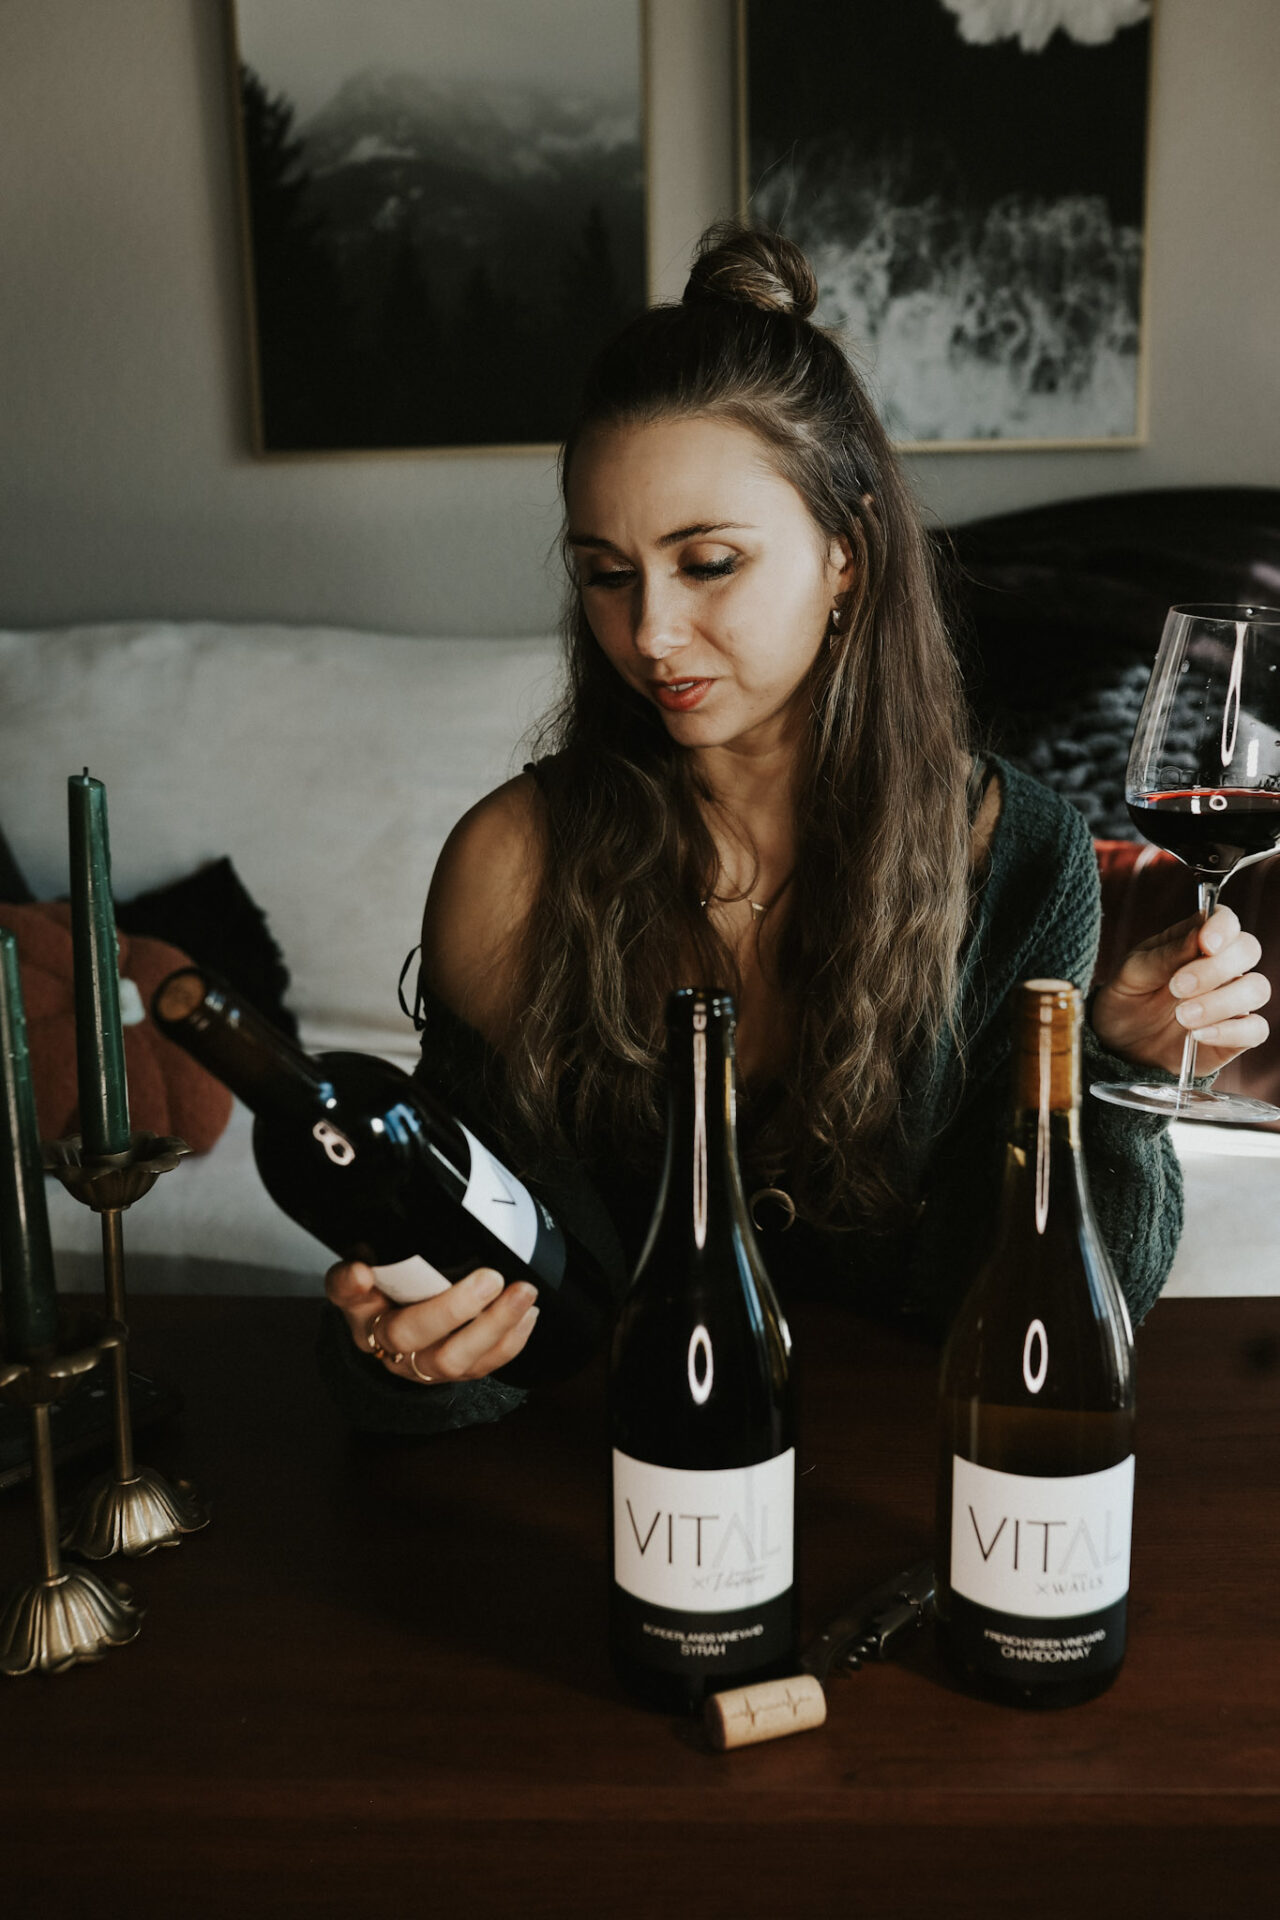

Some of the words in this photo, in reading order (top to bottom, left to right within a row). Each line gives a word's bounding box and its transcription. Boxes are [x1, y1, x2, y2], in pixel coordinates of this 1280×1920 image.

[624, 1496, 782, 1568] VITAL
[967, 1503, 1122, 1575] VITAL
[717, 1624, 764, 1643] VINEYARD
[984, 1628, 1025, 1648] FRENCH
[1026, 1637, 1061, 1649] CREEK
[1062, 1629, 1106, 1648] VINEYARD
[681, 1643, 726, 1656] SYRAH
[1000, 1645, 1092, 1663] CHARDONNAY
